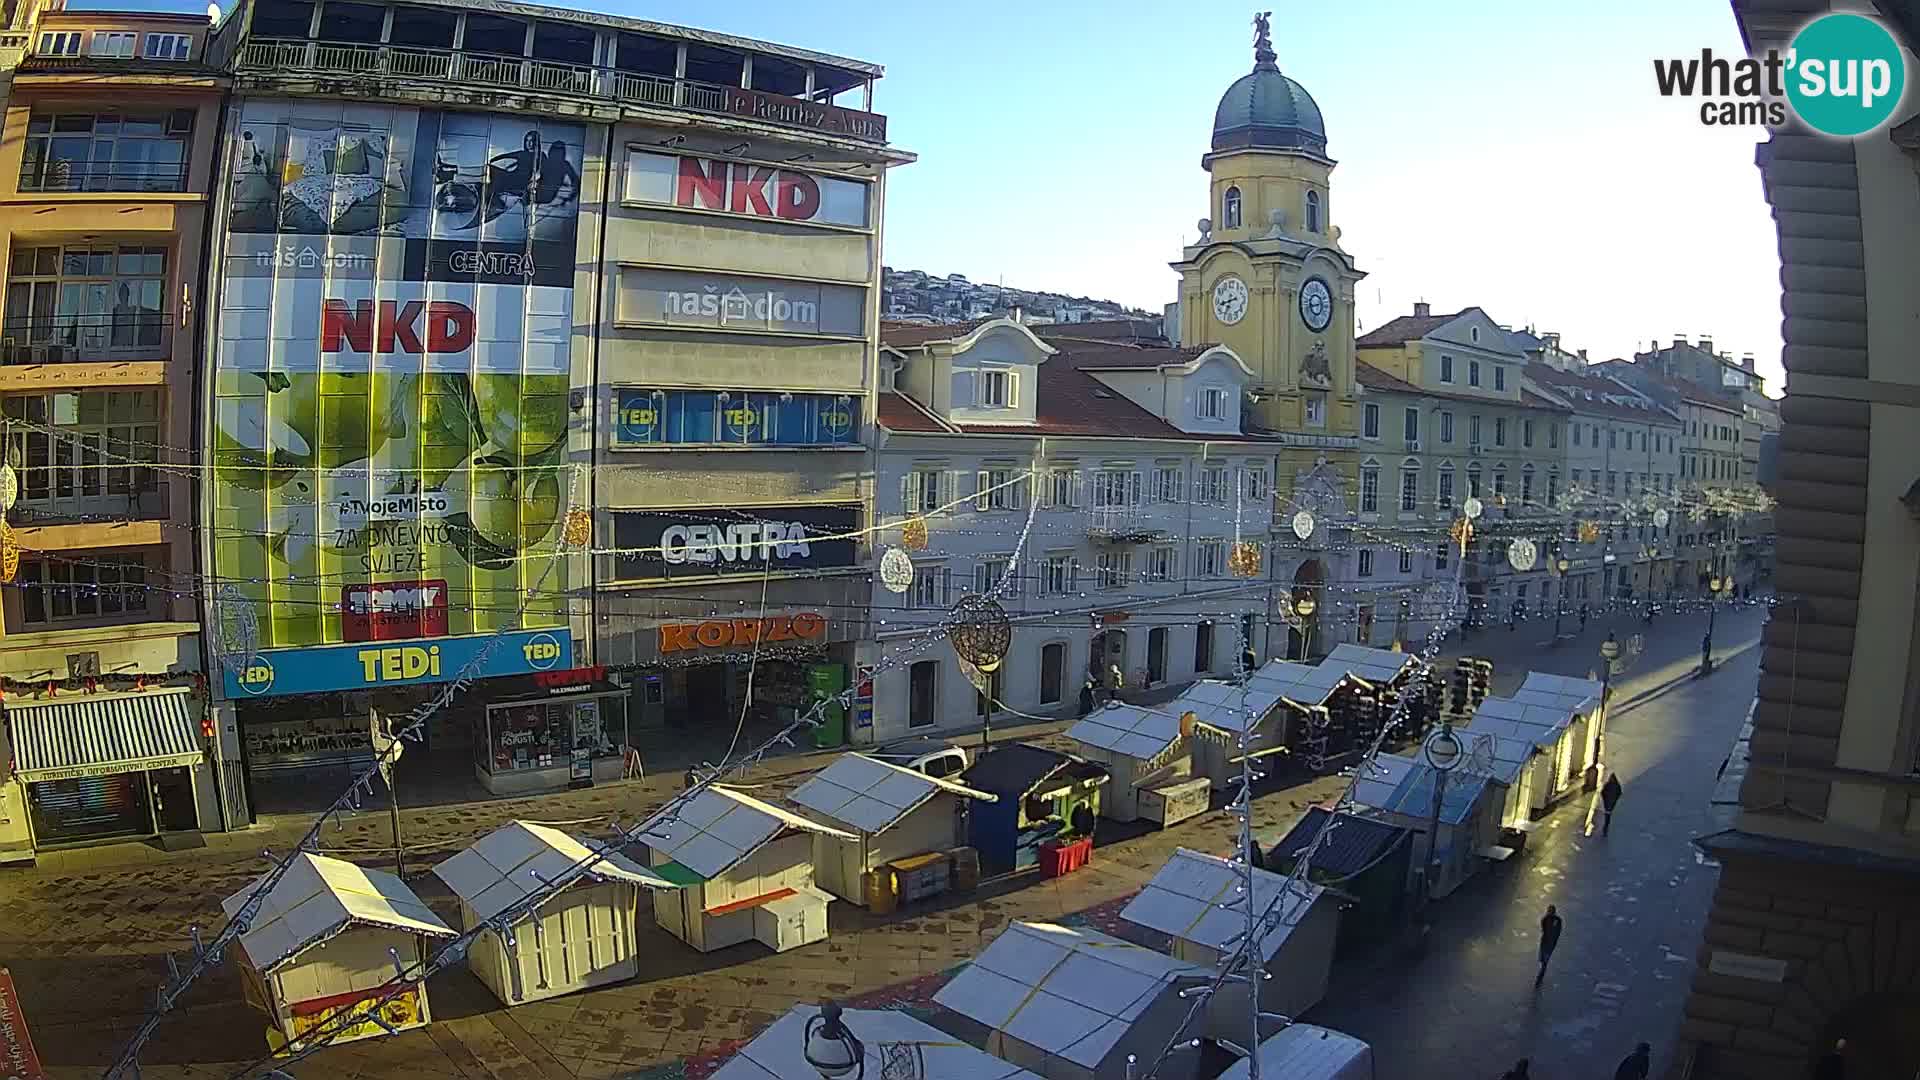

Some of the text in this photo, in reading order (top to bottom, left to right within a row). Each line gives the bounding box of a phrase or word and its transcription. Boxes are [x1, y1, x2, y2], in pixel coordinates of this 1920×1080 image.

[677, 156, 821, 220] NKD
[449, 250, 536, 277] CENTRA
[666, 283, 817, 324] naš dom
[322, 298, 476, 354] NKD
[339, 498, 447, 517] #TvojeMisto
[335, 523, 451, 549] ZA DNEVNO
[660, 521, 811, 565] CENTRA
[360, 547, 428, 575] SVJEŽE
[660, 613, 827, 655] KORZO
[359, 645, 441, 682] TEDi
[523, 643, 561, 660] TEDi
[87, 763, 143, 776] INFORMATIVNI
[146, 758, 178, 769] CENTAR
